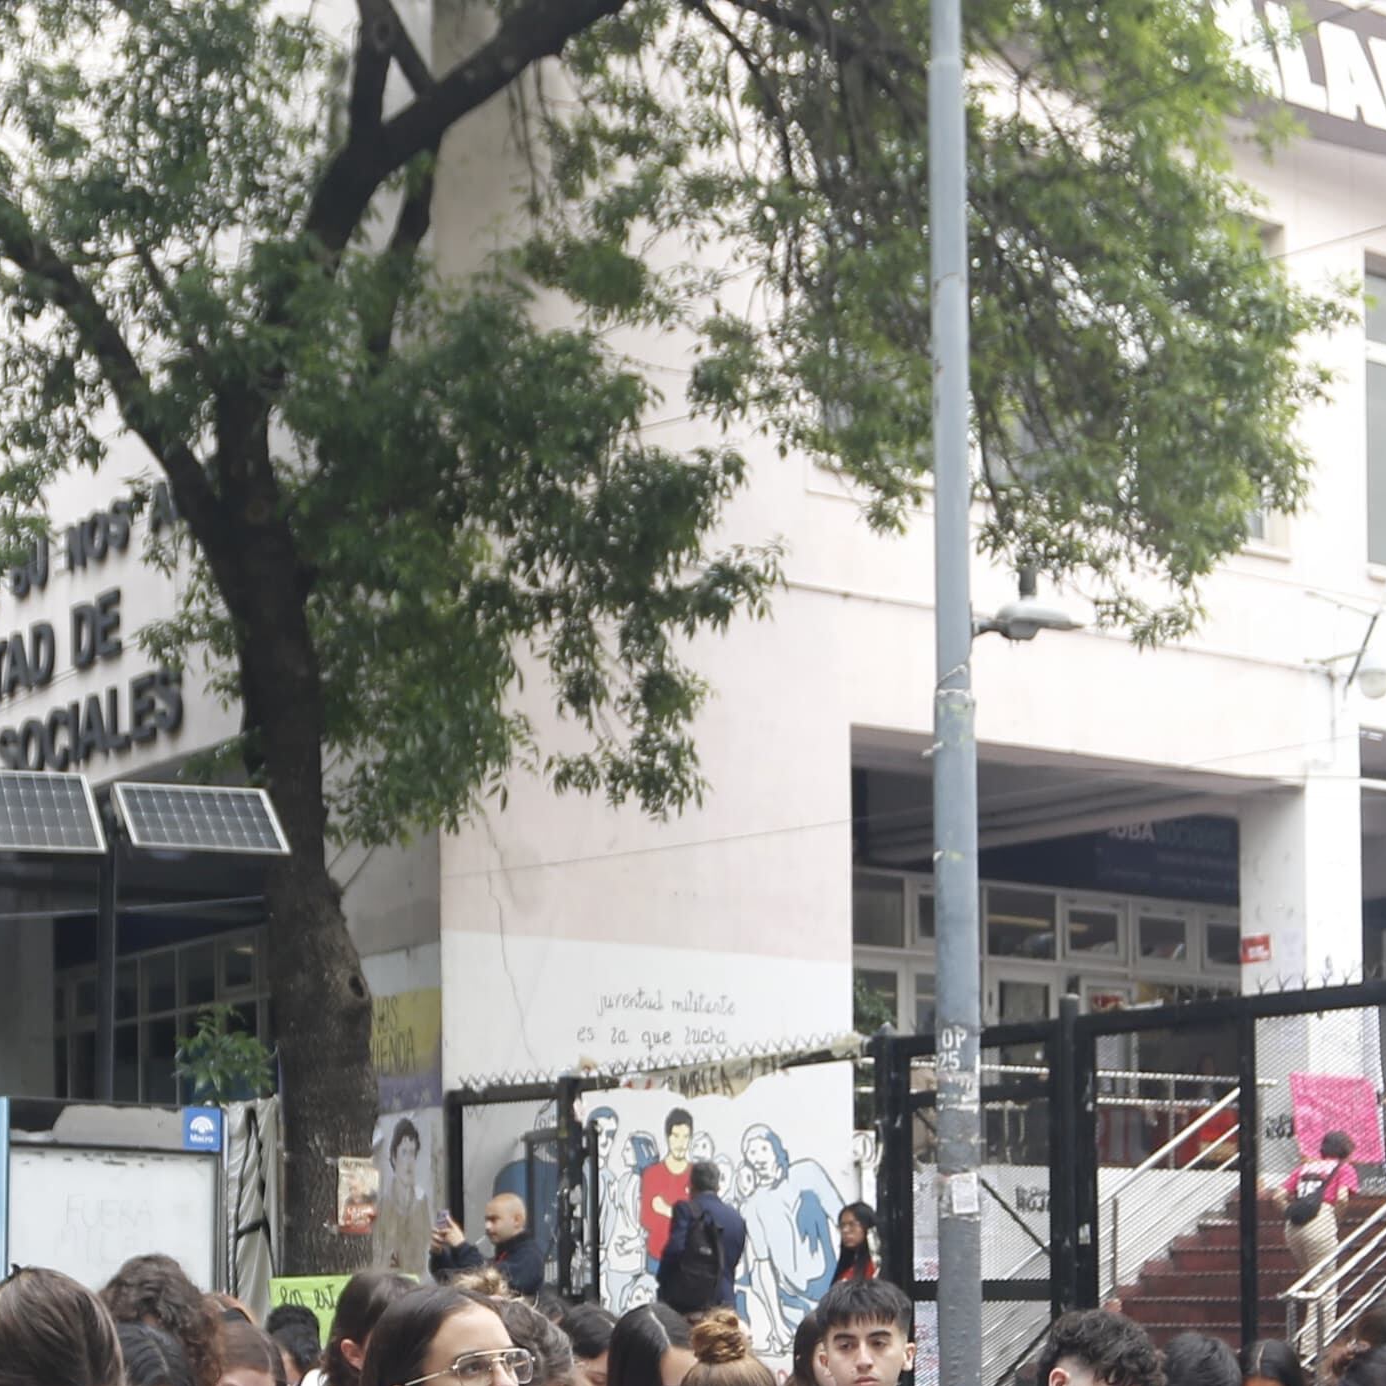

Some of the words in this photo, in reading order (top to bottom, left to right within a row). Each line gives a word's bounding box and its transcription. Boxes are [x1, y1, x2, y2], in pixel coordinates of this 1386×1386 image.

[71, 587, 123, 670] DE
[597, 987, 663, 1016] juventud
[672, 990, 735, 1016] militante
[577, 1026, 595, 1042] es
[611, 1026, 629, 1044] la
[641, 1029, 672, 1051] que
[684, 1025, 727, 1046] lucha
